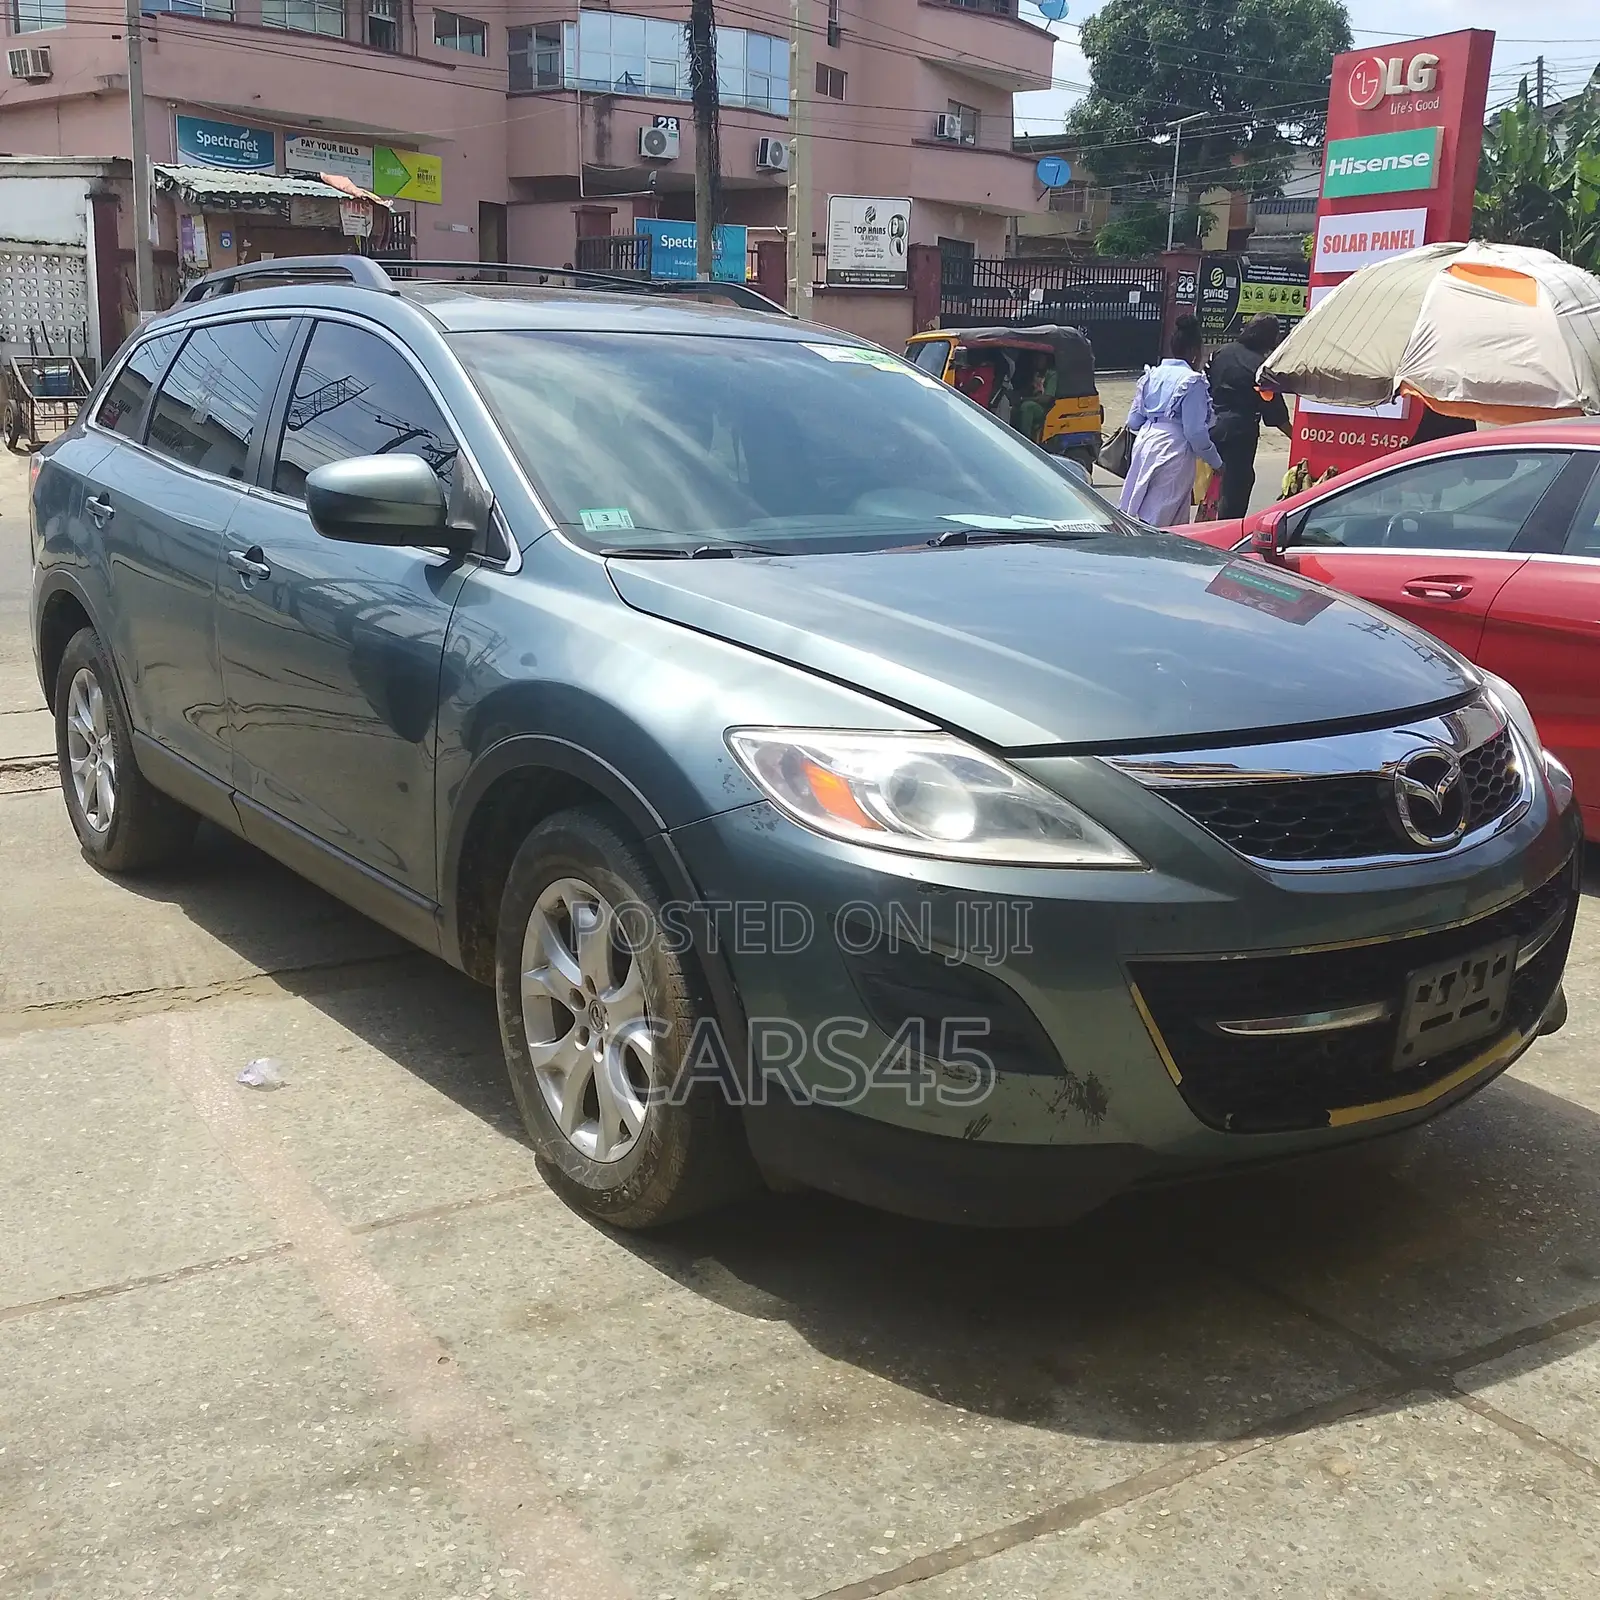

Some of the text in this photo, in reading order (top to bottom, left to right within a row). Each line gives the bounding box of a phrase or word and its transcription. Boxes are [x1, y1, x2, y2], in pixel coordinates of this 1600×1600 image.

[1385, 52, 1440, 95] LG
[1390, 96, 1439, 115] Life's Good
[657, 116, 677, 130] 28
[196, 130, 259, 152] Spectranet
[301, 138, 359, 156] PAY YOUR BILLS
[1328, 152, 1430, 177] Hisense
[854, 226, 867, 234] TOP
[1322, 229, 1415, 254] SOLAR PANEL
[1177, 275, 1195, 293] 28
[1300, 427, 1409, 448] 0902 004 5458
